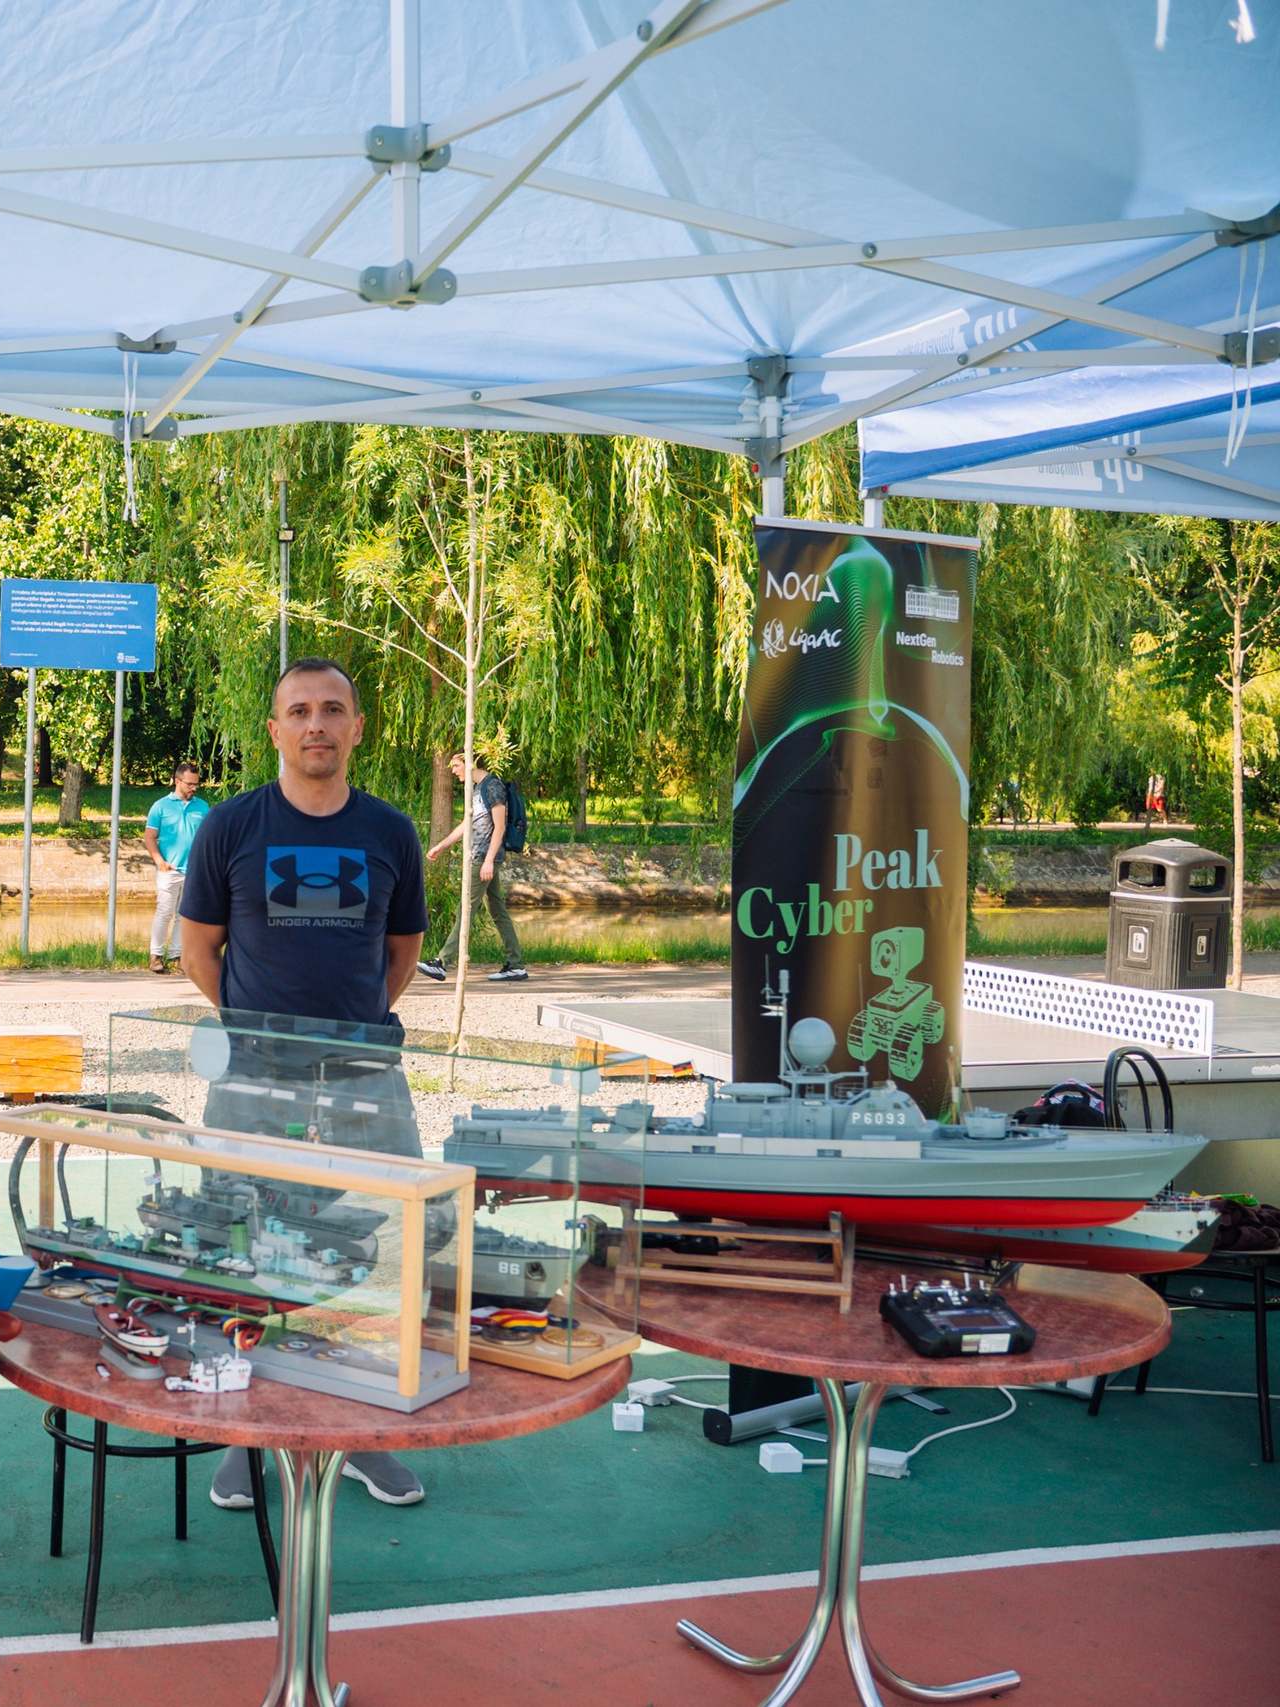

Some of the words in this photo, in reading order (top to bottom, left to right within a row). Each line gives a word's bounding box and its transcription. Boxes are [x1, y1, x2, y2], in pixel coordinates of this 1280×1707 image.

[765, 569, 841, 604] NOKIA
[896, 631, 937, 648] NextGen
[931, 647, 964, 666] Robotics
[833, 829, 943, 892] Peak
[267, 918, 311, 928] UNDER
[313, 918, 365, 929] ARMOUR
[737, 883, 873, 955] Cyber
[851, 1112, 906, 1125] P6093
[498, 1261, 521, 1275] 86
